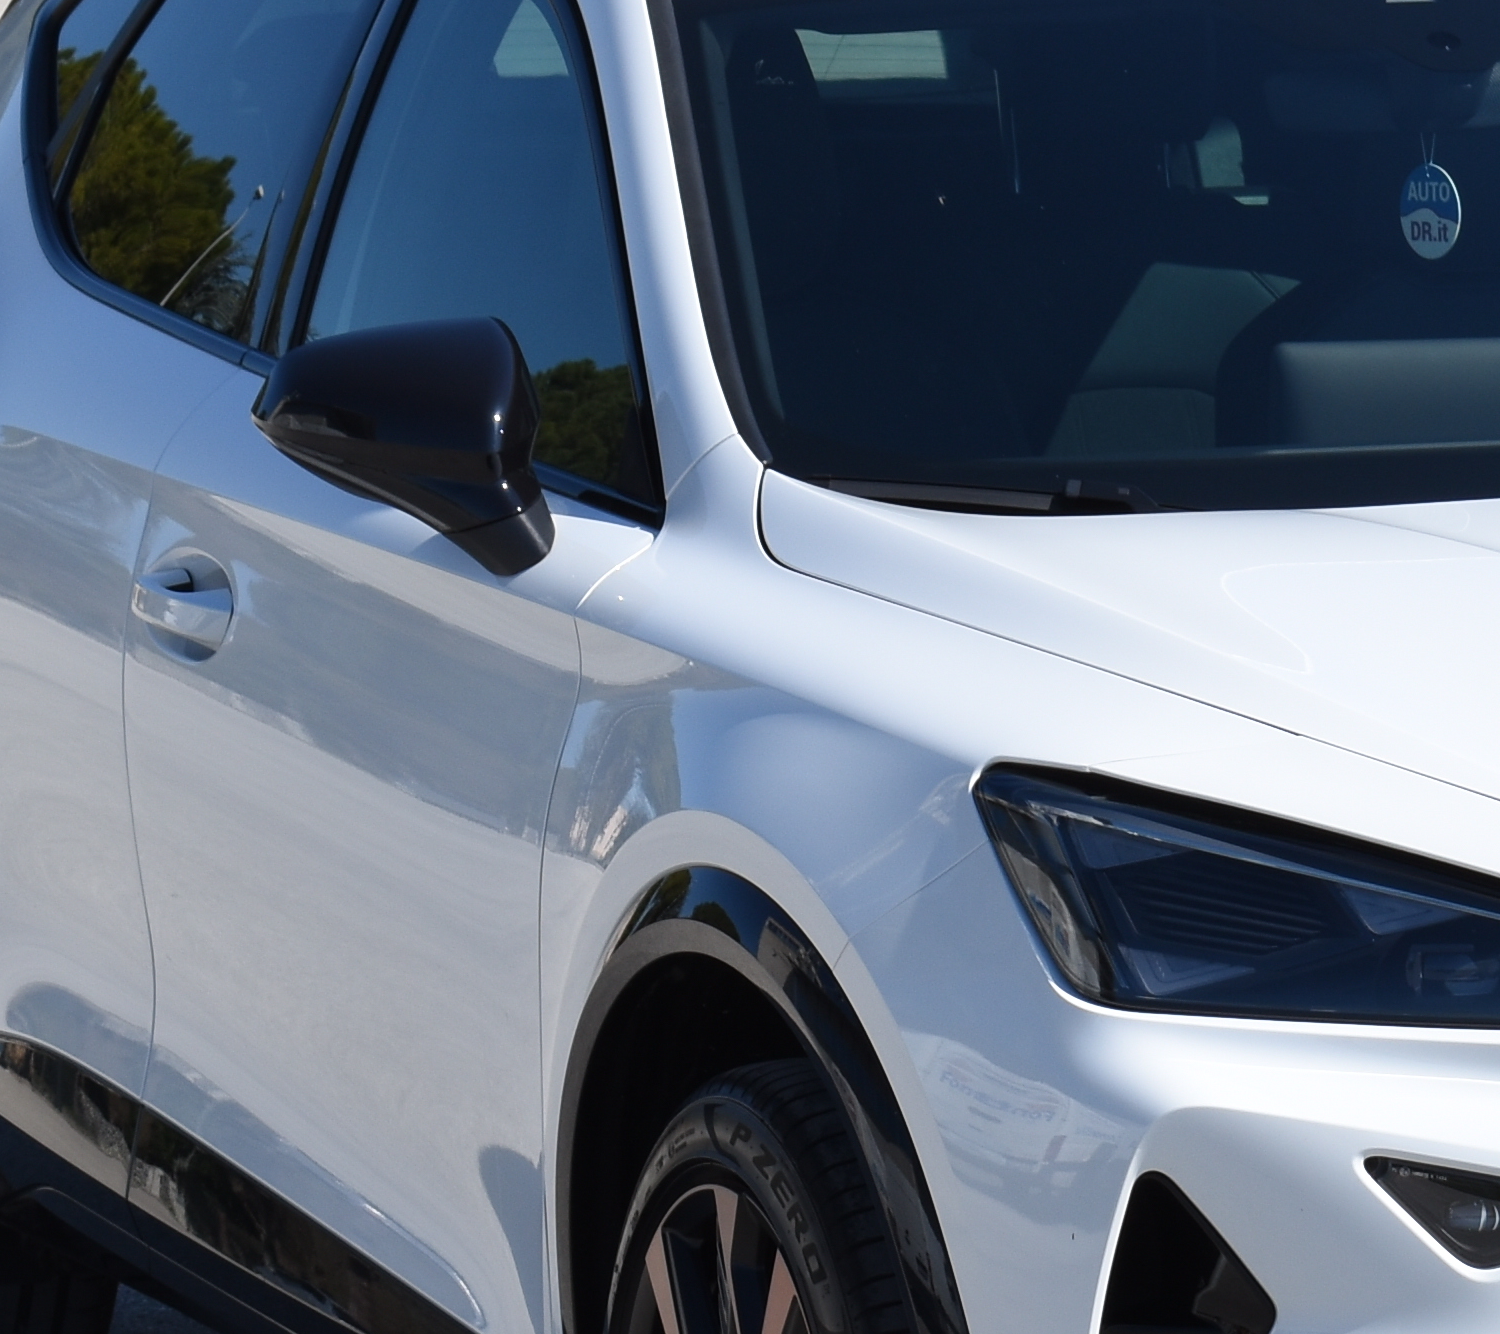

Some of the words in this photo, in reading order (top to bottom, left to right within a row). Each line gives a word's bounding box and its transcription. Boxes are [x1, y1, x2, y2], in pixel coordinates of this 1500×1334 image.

[1407, 180, 1451, 203] AUTO
[1410, 220, 1449, 243] DR.it
[729, 1122, 753, 1146] P
[752, 1143, 828, 1285] ZERO
